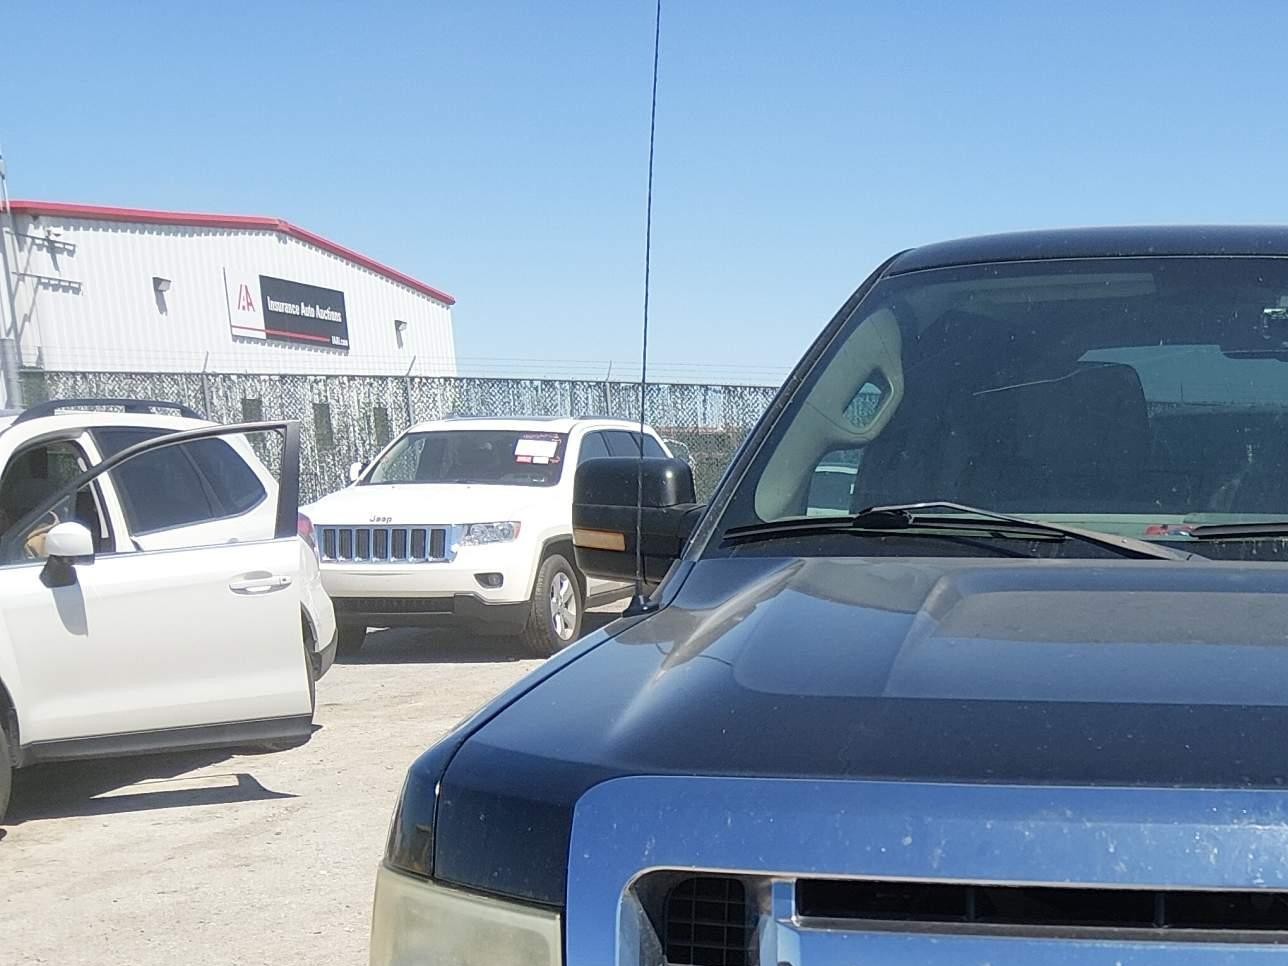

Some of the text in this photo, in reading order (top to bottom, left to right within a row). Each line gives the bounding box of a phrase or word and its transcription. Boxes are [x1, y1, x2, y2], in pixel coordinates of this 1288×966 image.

[266, 296, 342, 323] Insurance Auto Auctions
[369, 513, 392, 524] Jeep
